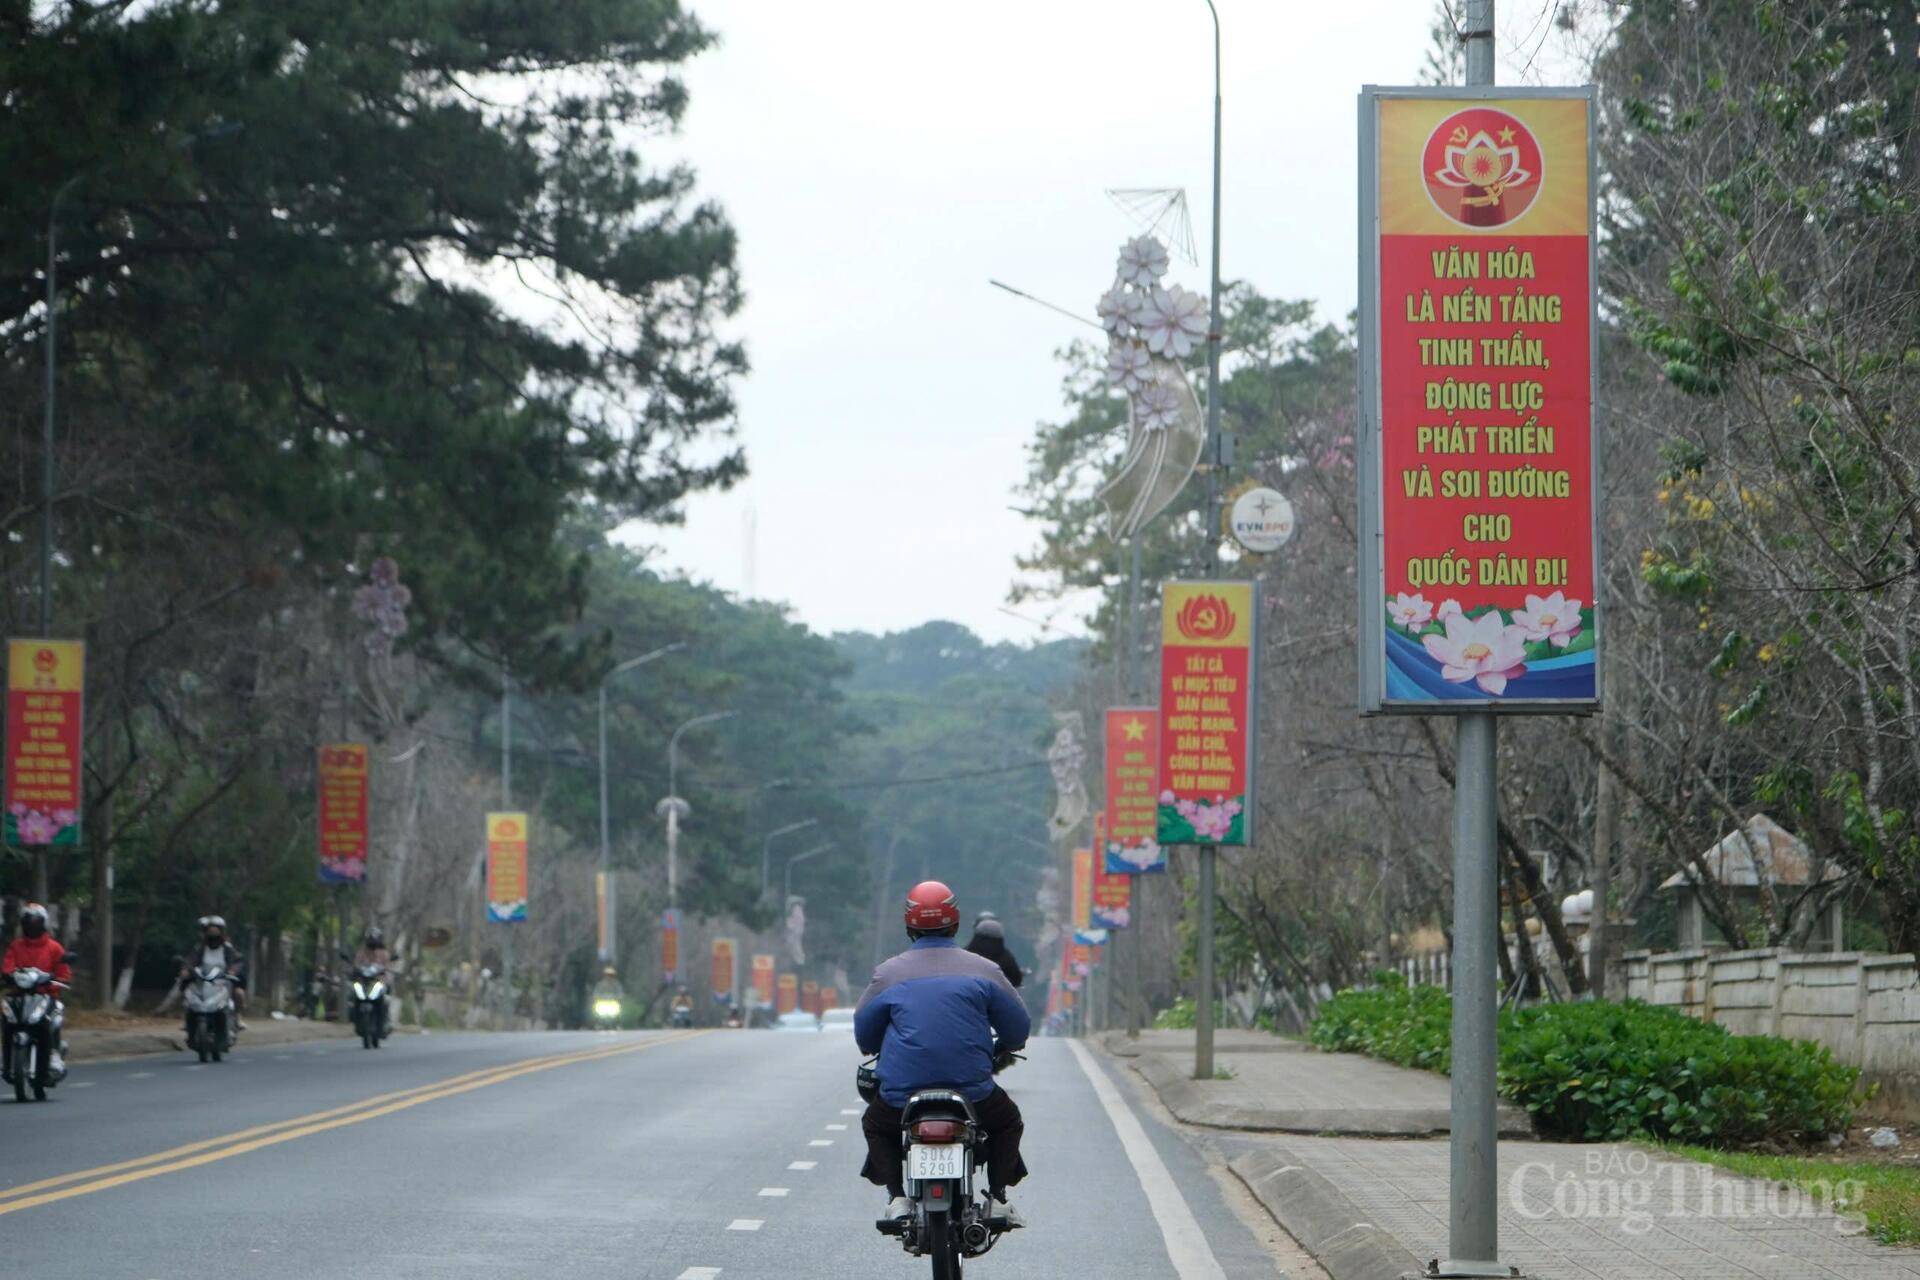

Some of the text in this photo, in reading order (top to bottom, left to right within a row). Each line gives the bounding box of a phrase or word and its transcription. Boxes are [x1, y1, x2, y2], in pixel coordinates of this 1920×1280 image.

[1432, 246, 1535, 278] VĂN HÓA
[1406, 286, 1562, 322] LÀ NỀN TẢNG
[1418, 330, 1550, 370] TINH THẦN,
[1426, 377, 1544, 415] ĐỘNG LỰC
[1417, 416, 1554, 453] PHÁT TRIỂN
[1403, 464, 1570, 497] VÀ SOI ĐƯỜNG
[1463, 514, 1511, 541] CHO
[1407, 549, 1568, 588] QUỐC DÂN ĐI!
[919, 1161, 954, 1176] 5290
